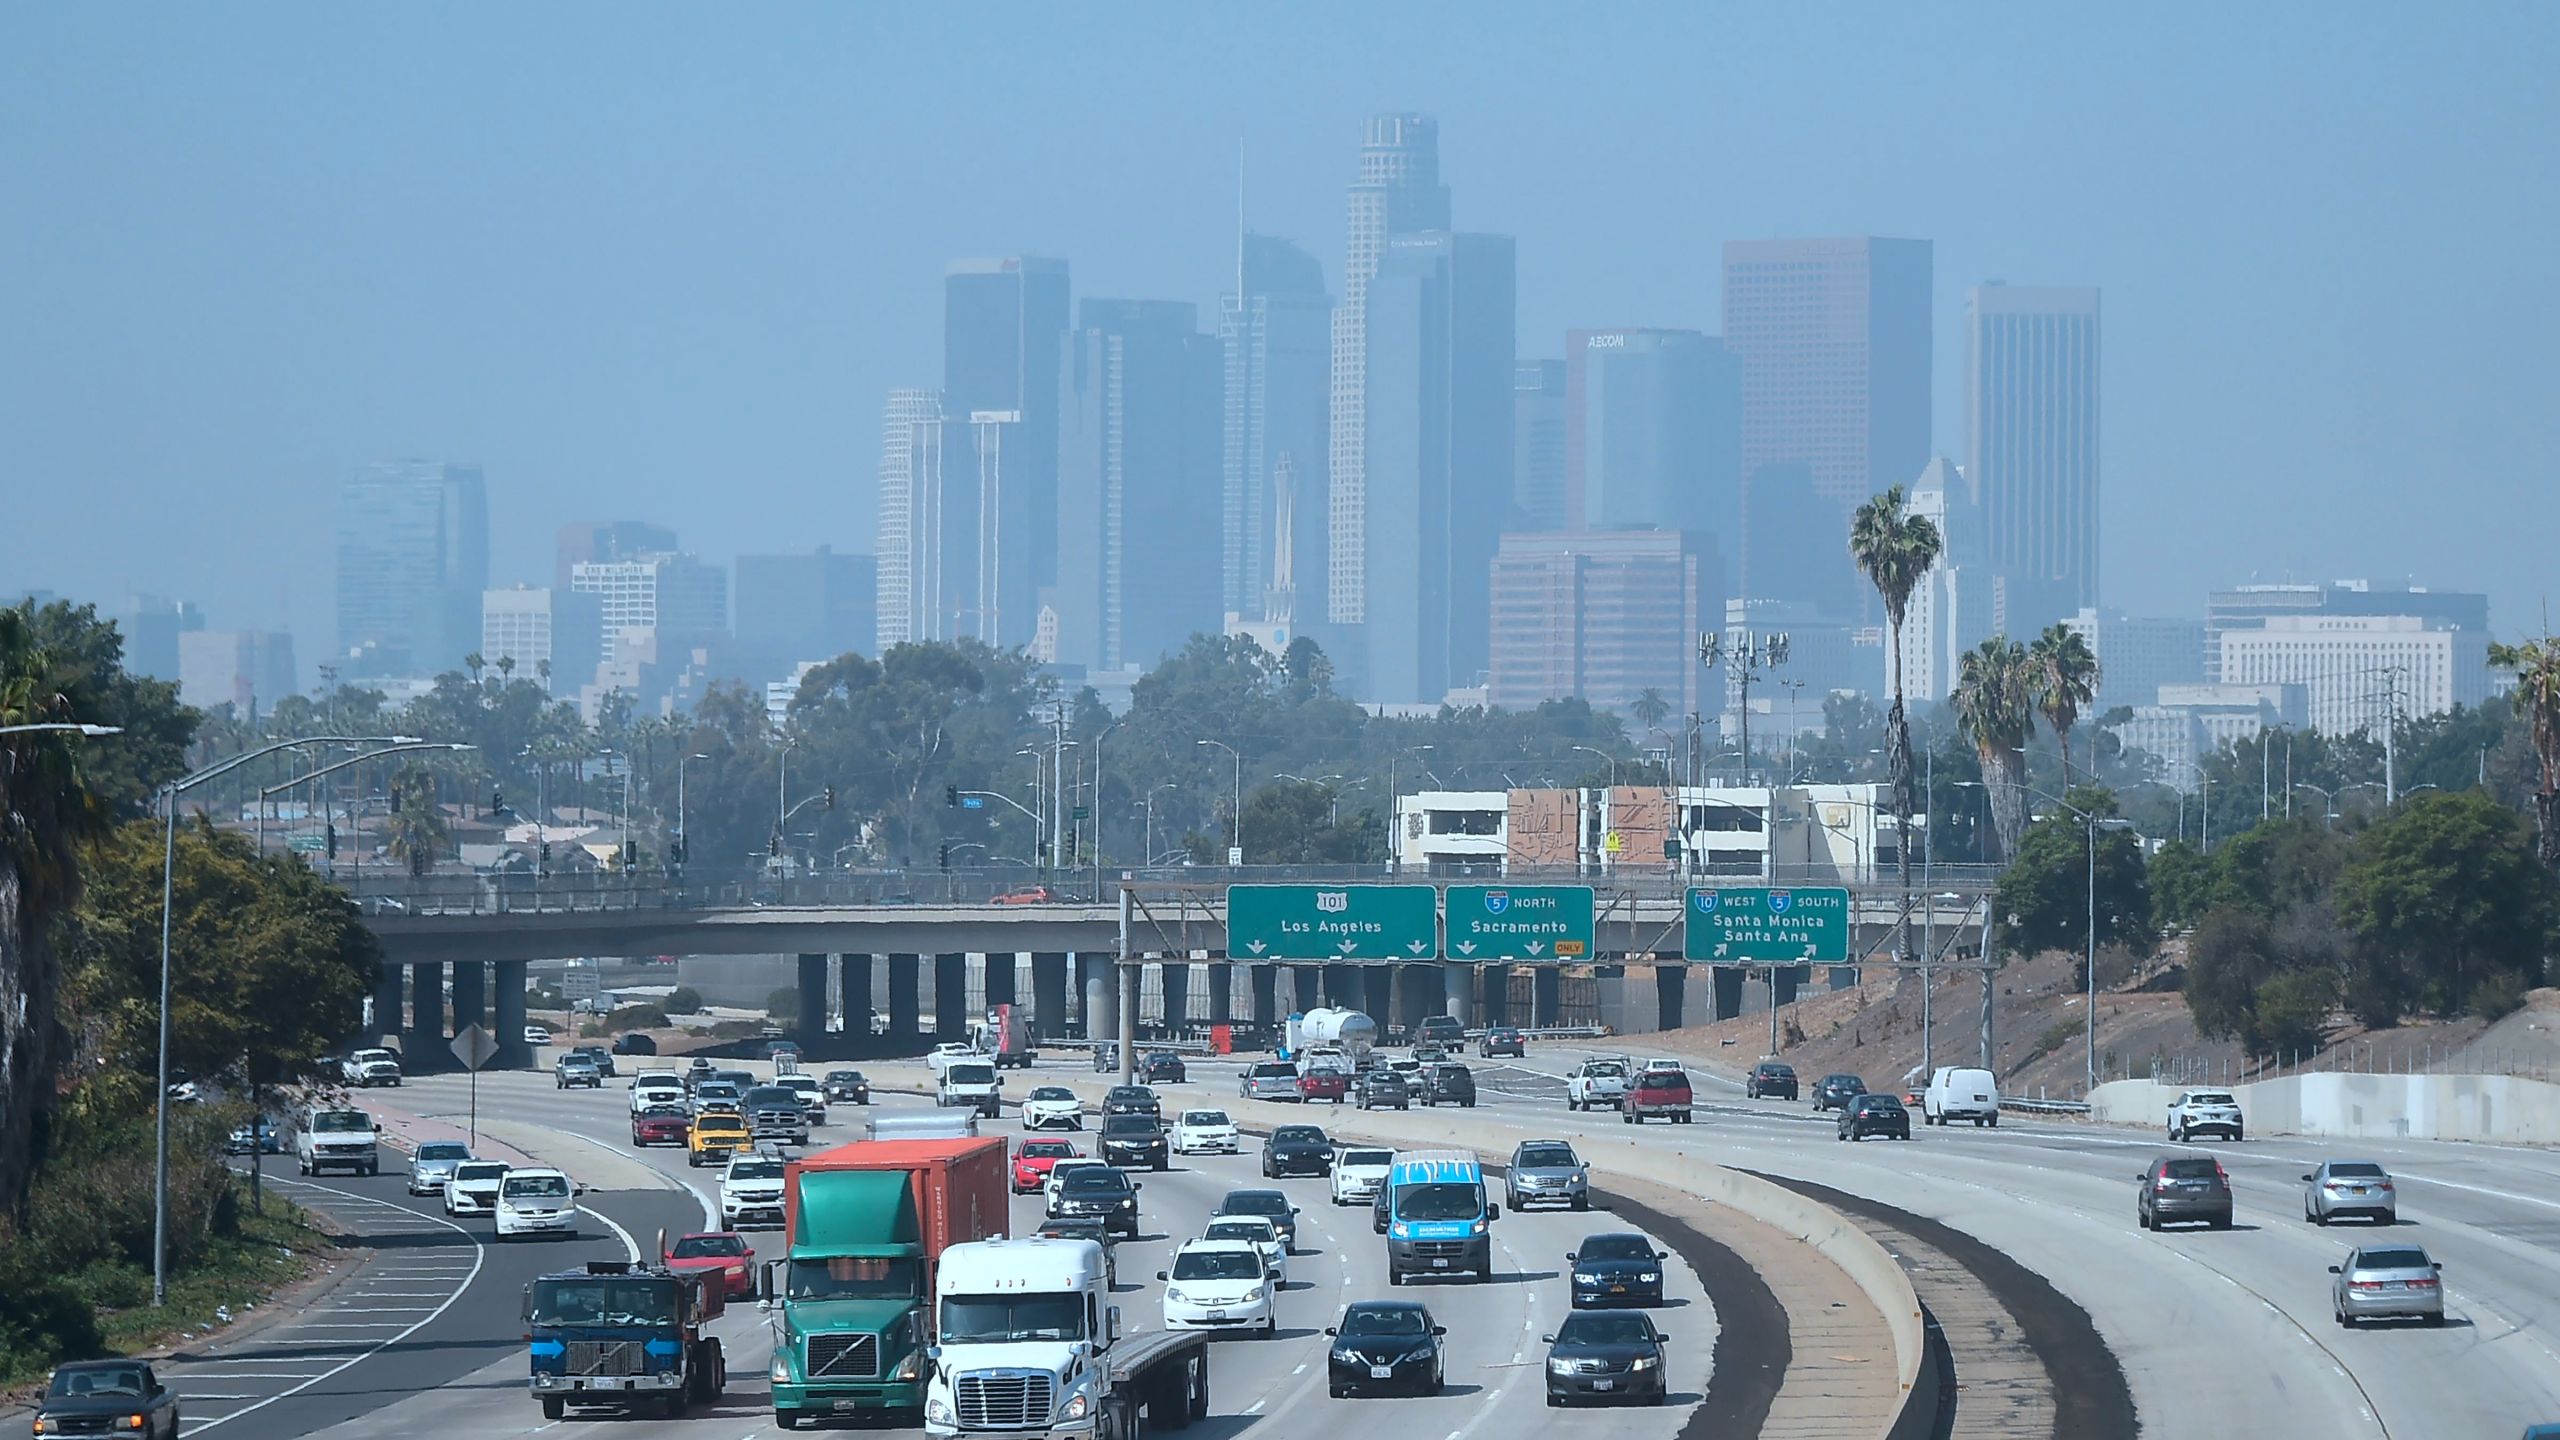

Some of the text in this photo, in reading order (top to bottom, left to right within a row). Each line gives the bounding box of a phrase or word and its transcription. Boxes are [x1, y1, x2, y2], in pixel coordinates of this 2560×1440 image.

[1588, 334, 1624, 348] AECOM
[1322, 897, 1342, 908] 101
[1493, 898, 1556, 909] 5 NORTH
[1700, 897, 1839, 908] 10 WEST 5 SOUTH
[1471, 920, 1567, 933] Sacramento
[1713, 914, 1824, 927] Santa Monica
[1281, 920, 1382, 935] Los Angeles
[1724, 930, 1808, 942] Santa Ana
[1557, 944, 1580, 953] ONLY
